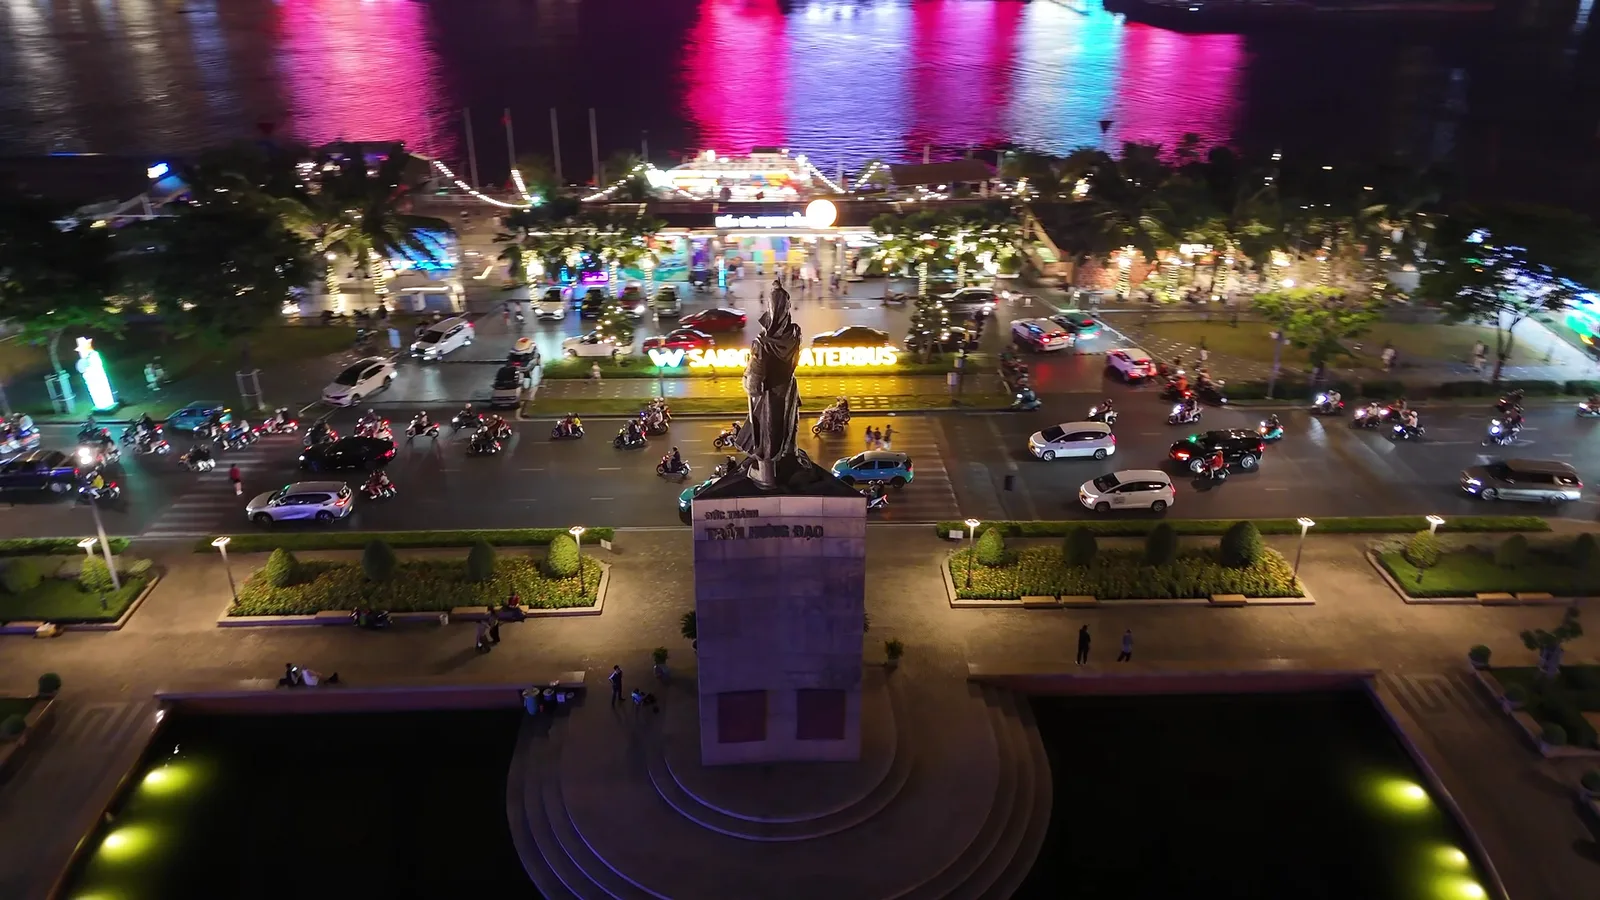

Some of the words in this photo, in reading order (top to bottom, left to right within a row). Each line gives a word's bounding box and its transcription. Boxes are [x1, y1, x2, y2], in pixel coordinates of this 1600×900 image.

[688, 348, 752, 368] SAIGO
[797, 347, 898, 367] ATERBUS
[792, 524, 824, 541] ĐẠO
